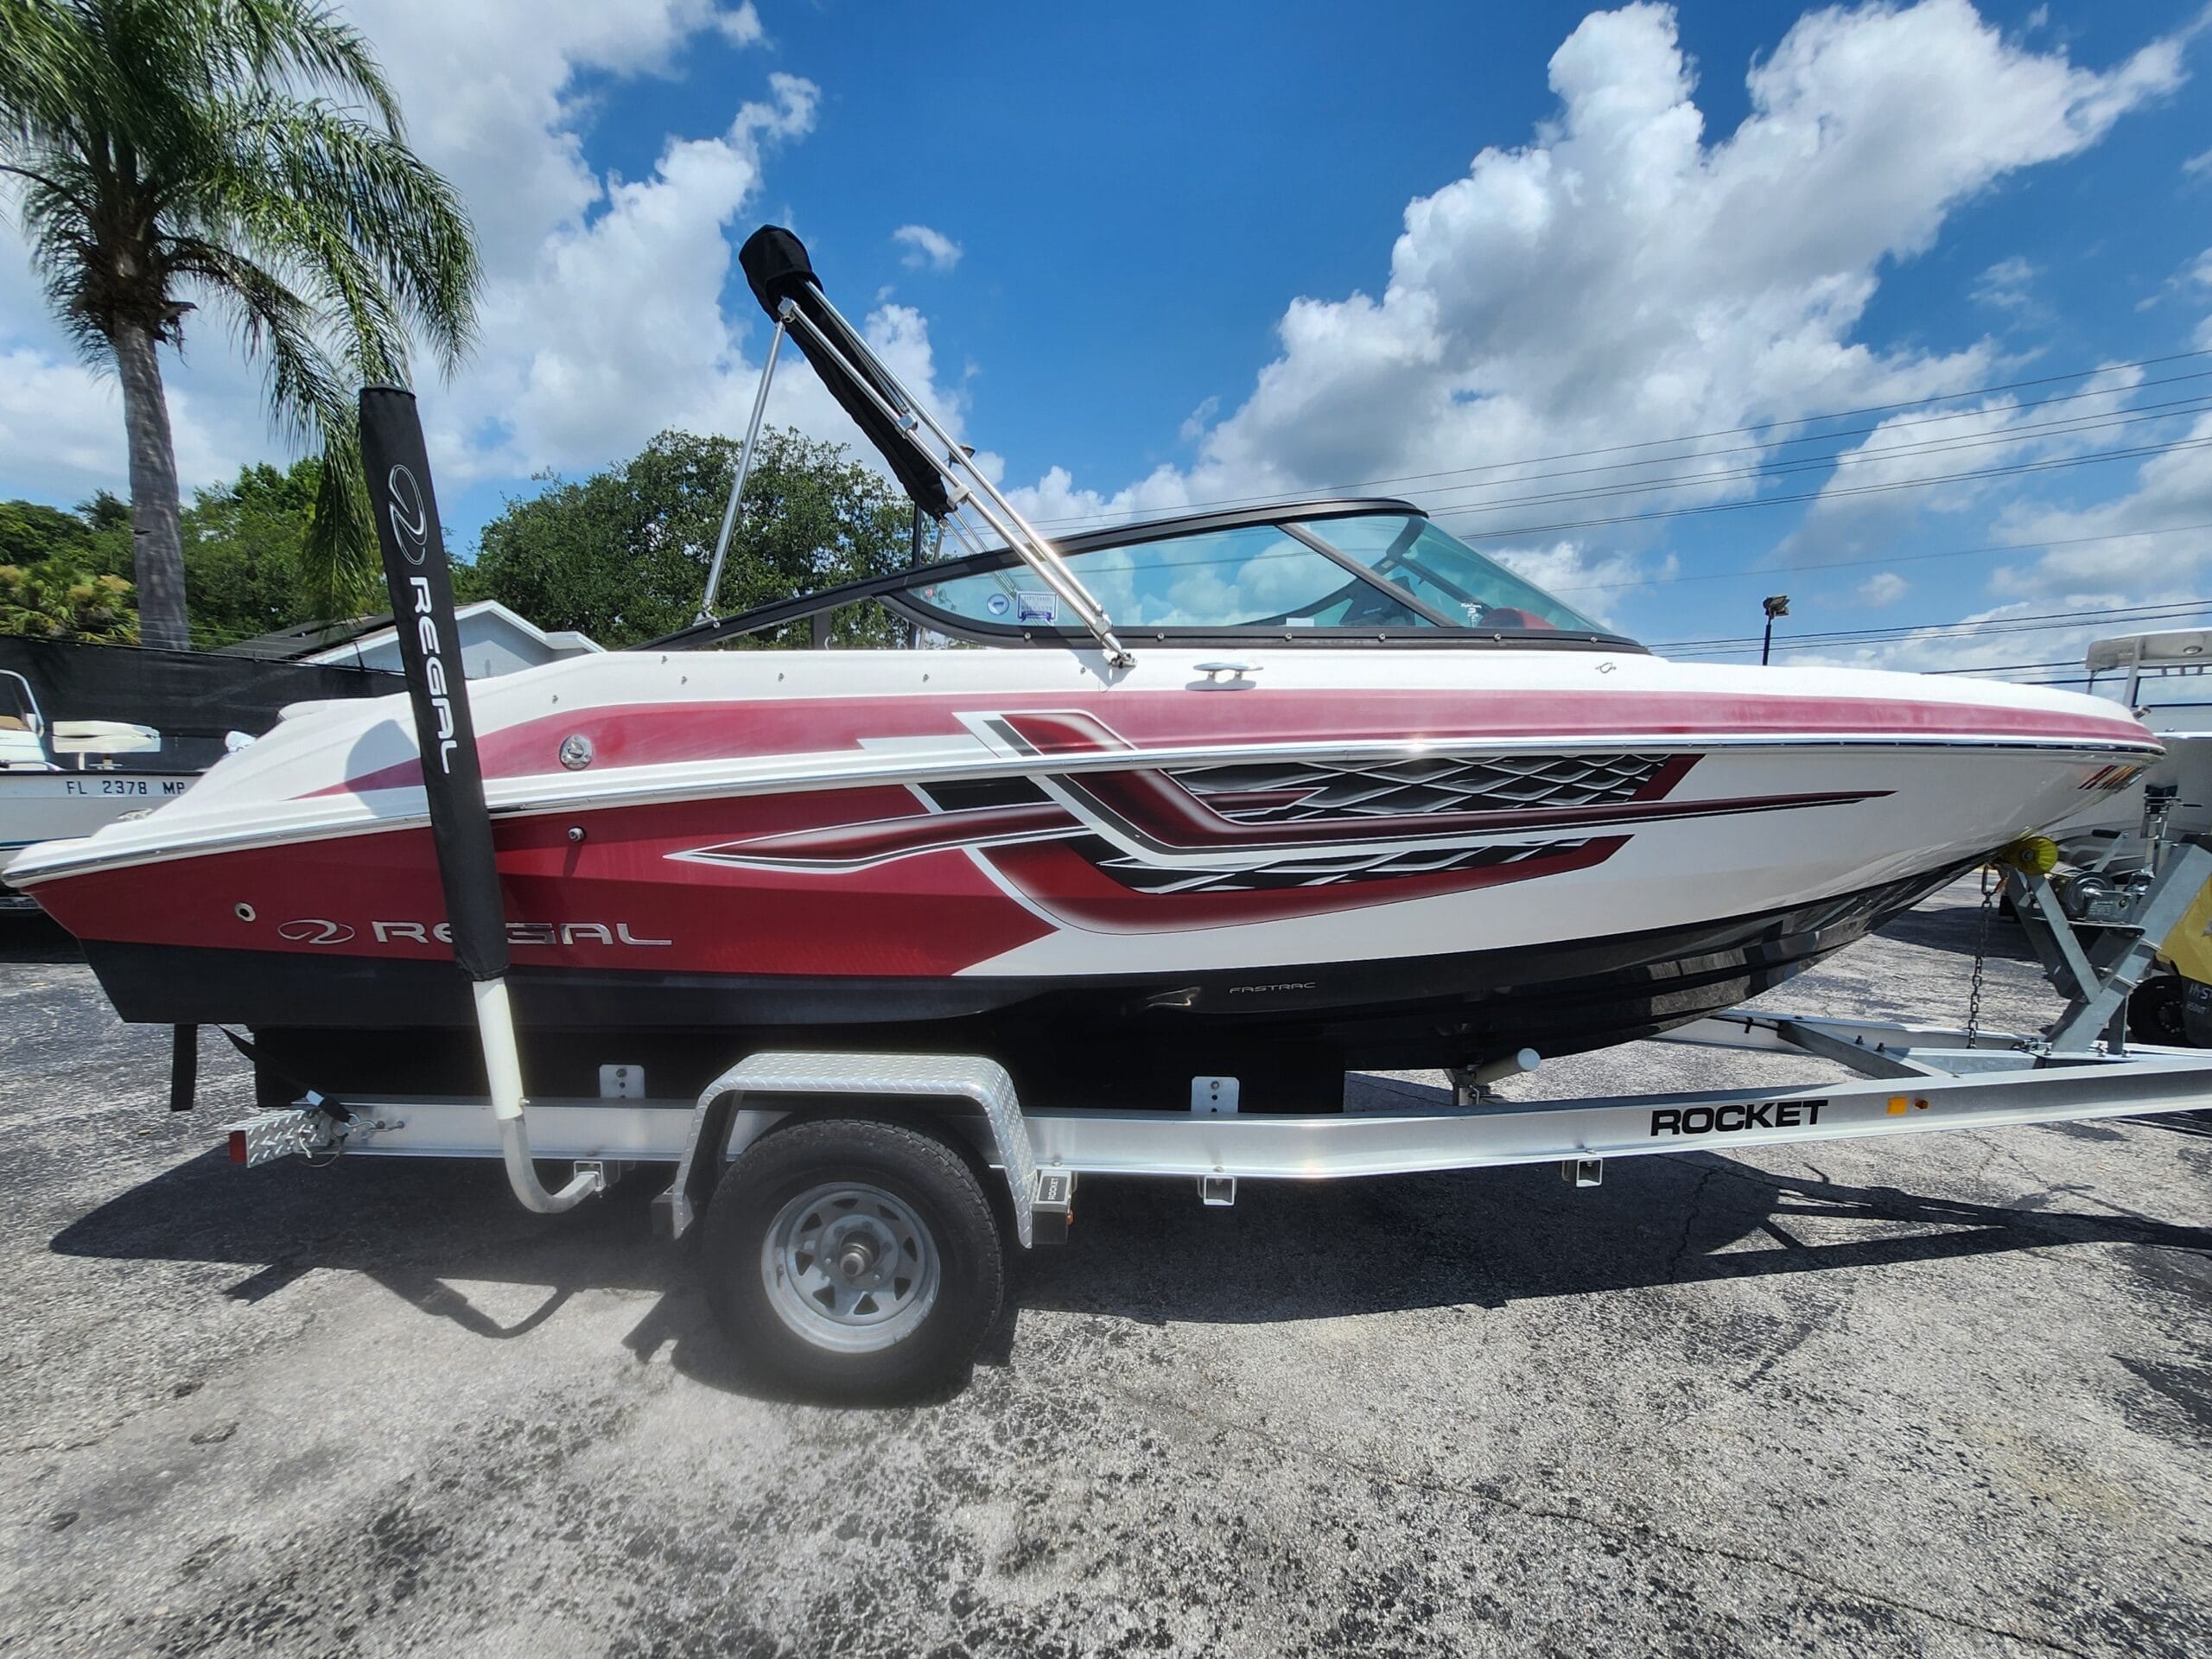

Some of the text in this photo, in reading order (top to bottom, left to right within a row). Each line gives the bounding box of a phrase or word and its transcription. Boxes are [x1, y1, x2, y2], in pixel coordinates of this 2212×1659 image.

[410, 575, 458, 774] REGAL
[67, 780, 186, 795] FL 2378 MP
[1229, 982, 1317, 994] FASTRAC
[1650, 1099, 1828, 1136] ROCKET
